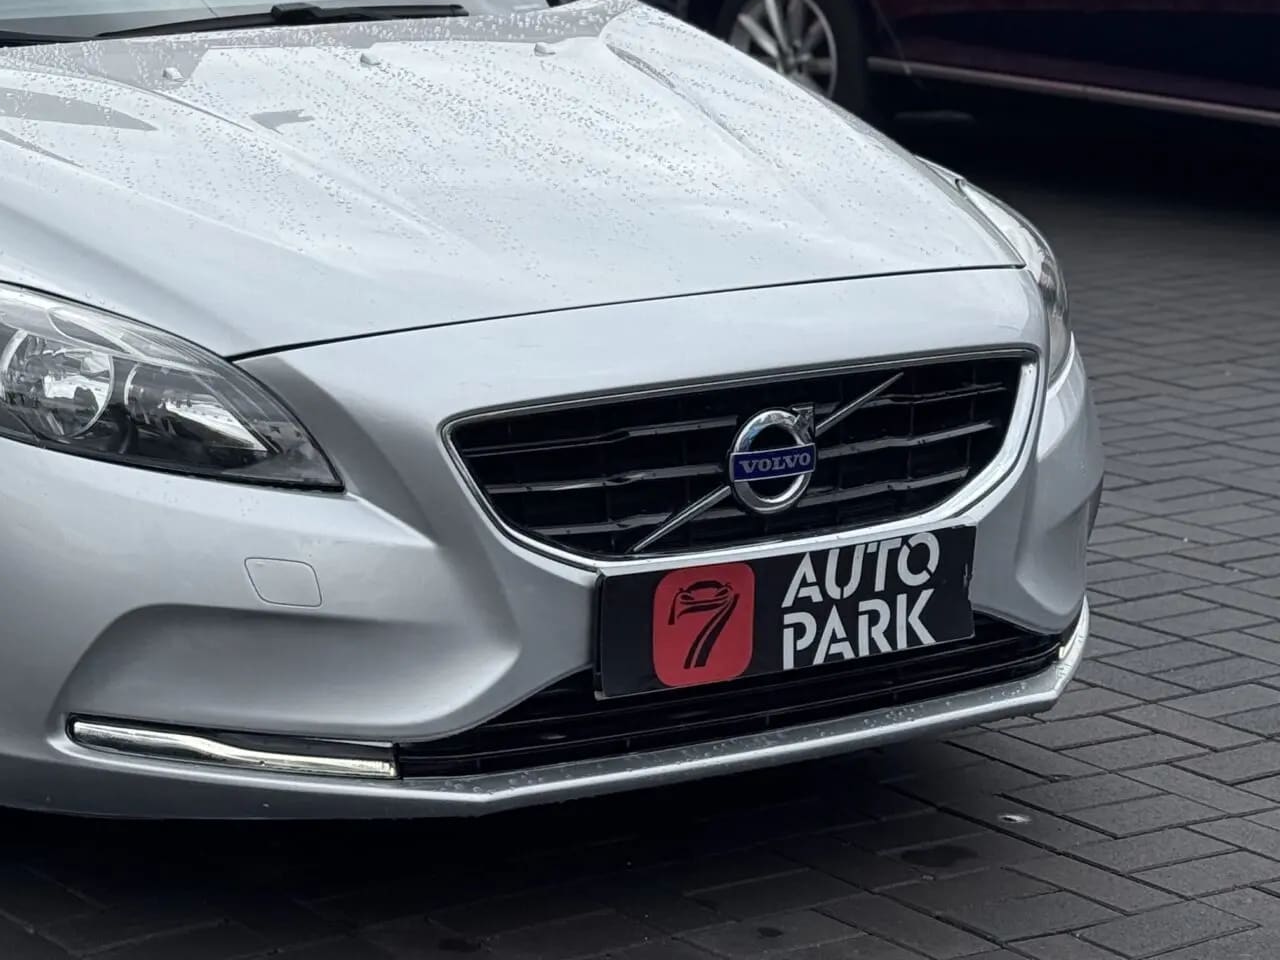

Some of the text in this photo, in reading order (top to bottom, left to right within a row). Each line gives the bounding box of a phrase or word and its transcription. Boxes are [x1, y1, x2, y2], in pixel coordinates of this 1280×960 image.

[738, 451, 812, 474] VOLVO
[781, 532, 941, 608] AUTO
[783, 588, 937, 671] PARK
